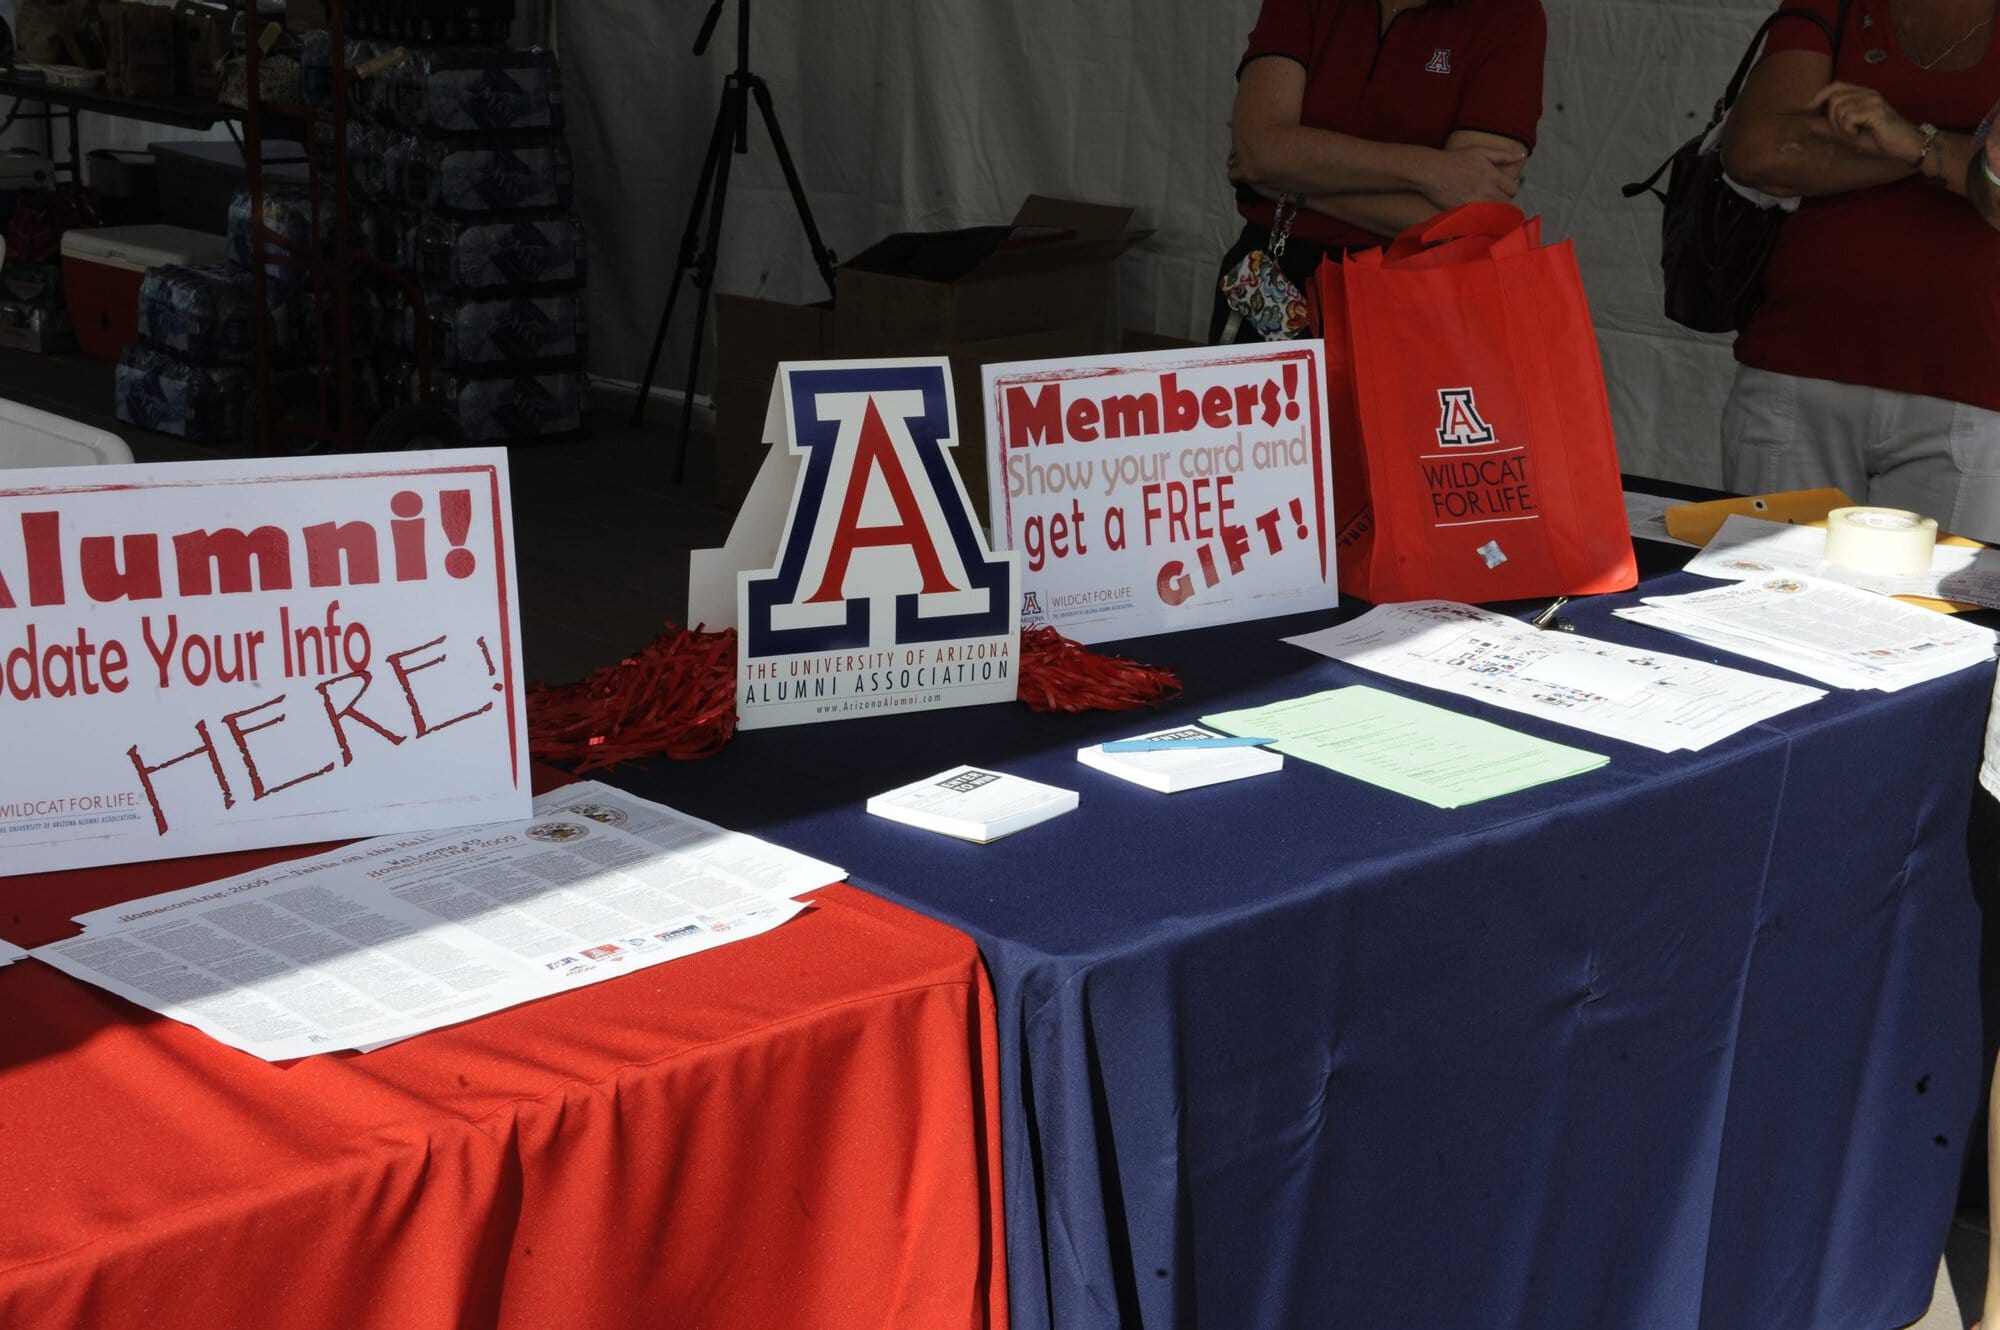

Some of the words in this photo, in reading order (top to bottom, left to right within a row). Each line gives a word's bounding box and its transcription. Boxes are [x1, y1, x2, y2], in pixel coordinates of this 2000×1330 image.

[1006, 364, 1300, 449] Members!
[1008, 453, 1093, 498] Show
[1101, 452, 1171, 496] your
[1179, 432, 1244, 478] card
[1252, 424, 1307, 470] and
[1422, 456, 1526, 489] WILDCAT
[1024, 498, 1087, 571] get
[1104, 506, 1126, 551] a
[1142, 476, 1237, 546] FREE
[1432, 491, 1485, 518] FOR
[0, 489, 476, 608] lumni!
[1156, 497, 1308, 606] GIFT!
[1052, 592, 1091, 608] WILDCAT
[1094, 589, 1112, 603] FOR
[142, 614, 265, 688] Your
[280, 600, 371, 677] Info
[747, 663, 777, 680] THE
[790, 652, 894, 677] UNIVERSITY
[906, 649, 924, 666] OF
[936, 642, 1008, 663] ARIZONA
[746, 676, 836, 705] ALUMNI
[855, 660, 1008, 693] ASSOCIATION
[816, 694, 941, 714] www.ArizonaAlumni.com
[127, 635, 503, 836] HERE!
[940, 772, 983, 788] ENTER
[70, 796, 102, 811] FOR
[387, 845, 459, 866] Welcome
[481, 835, 518, 849] 2009
[119, 891, 227, 923] Homecoming
[228, 878, 270, 896] 2009
[289, 860, 340, 877] Tents
[342, 854, 363, 864] on
[366, 845, 395, 858] the
